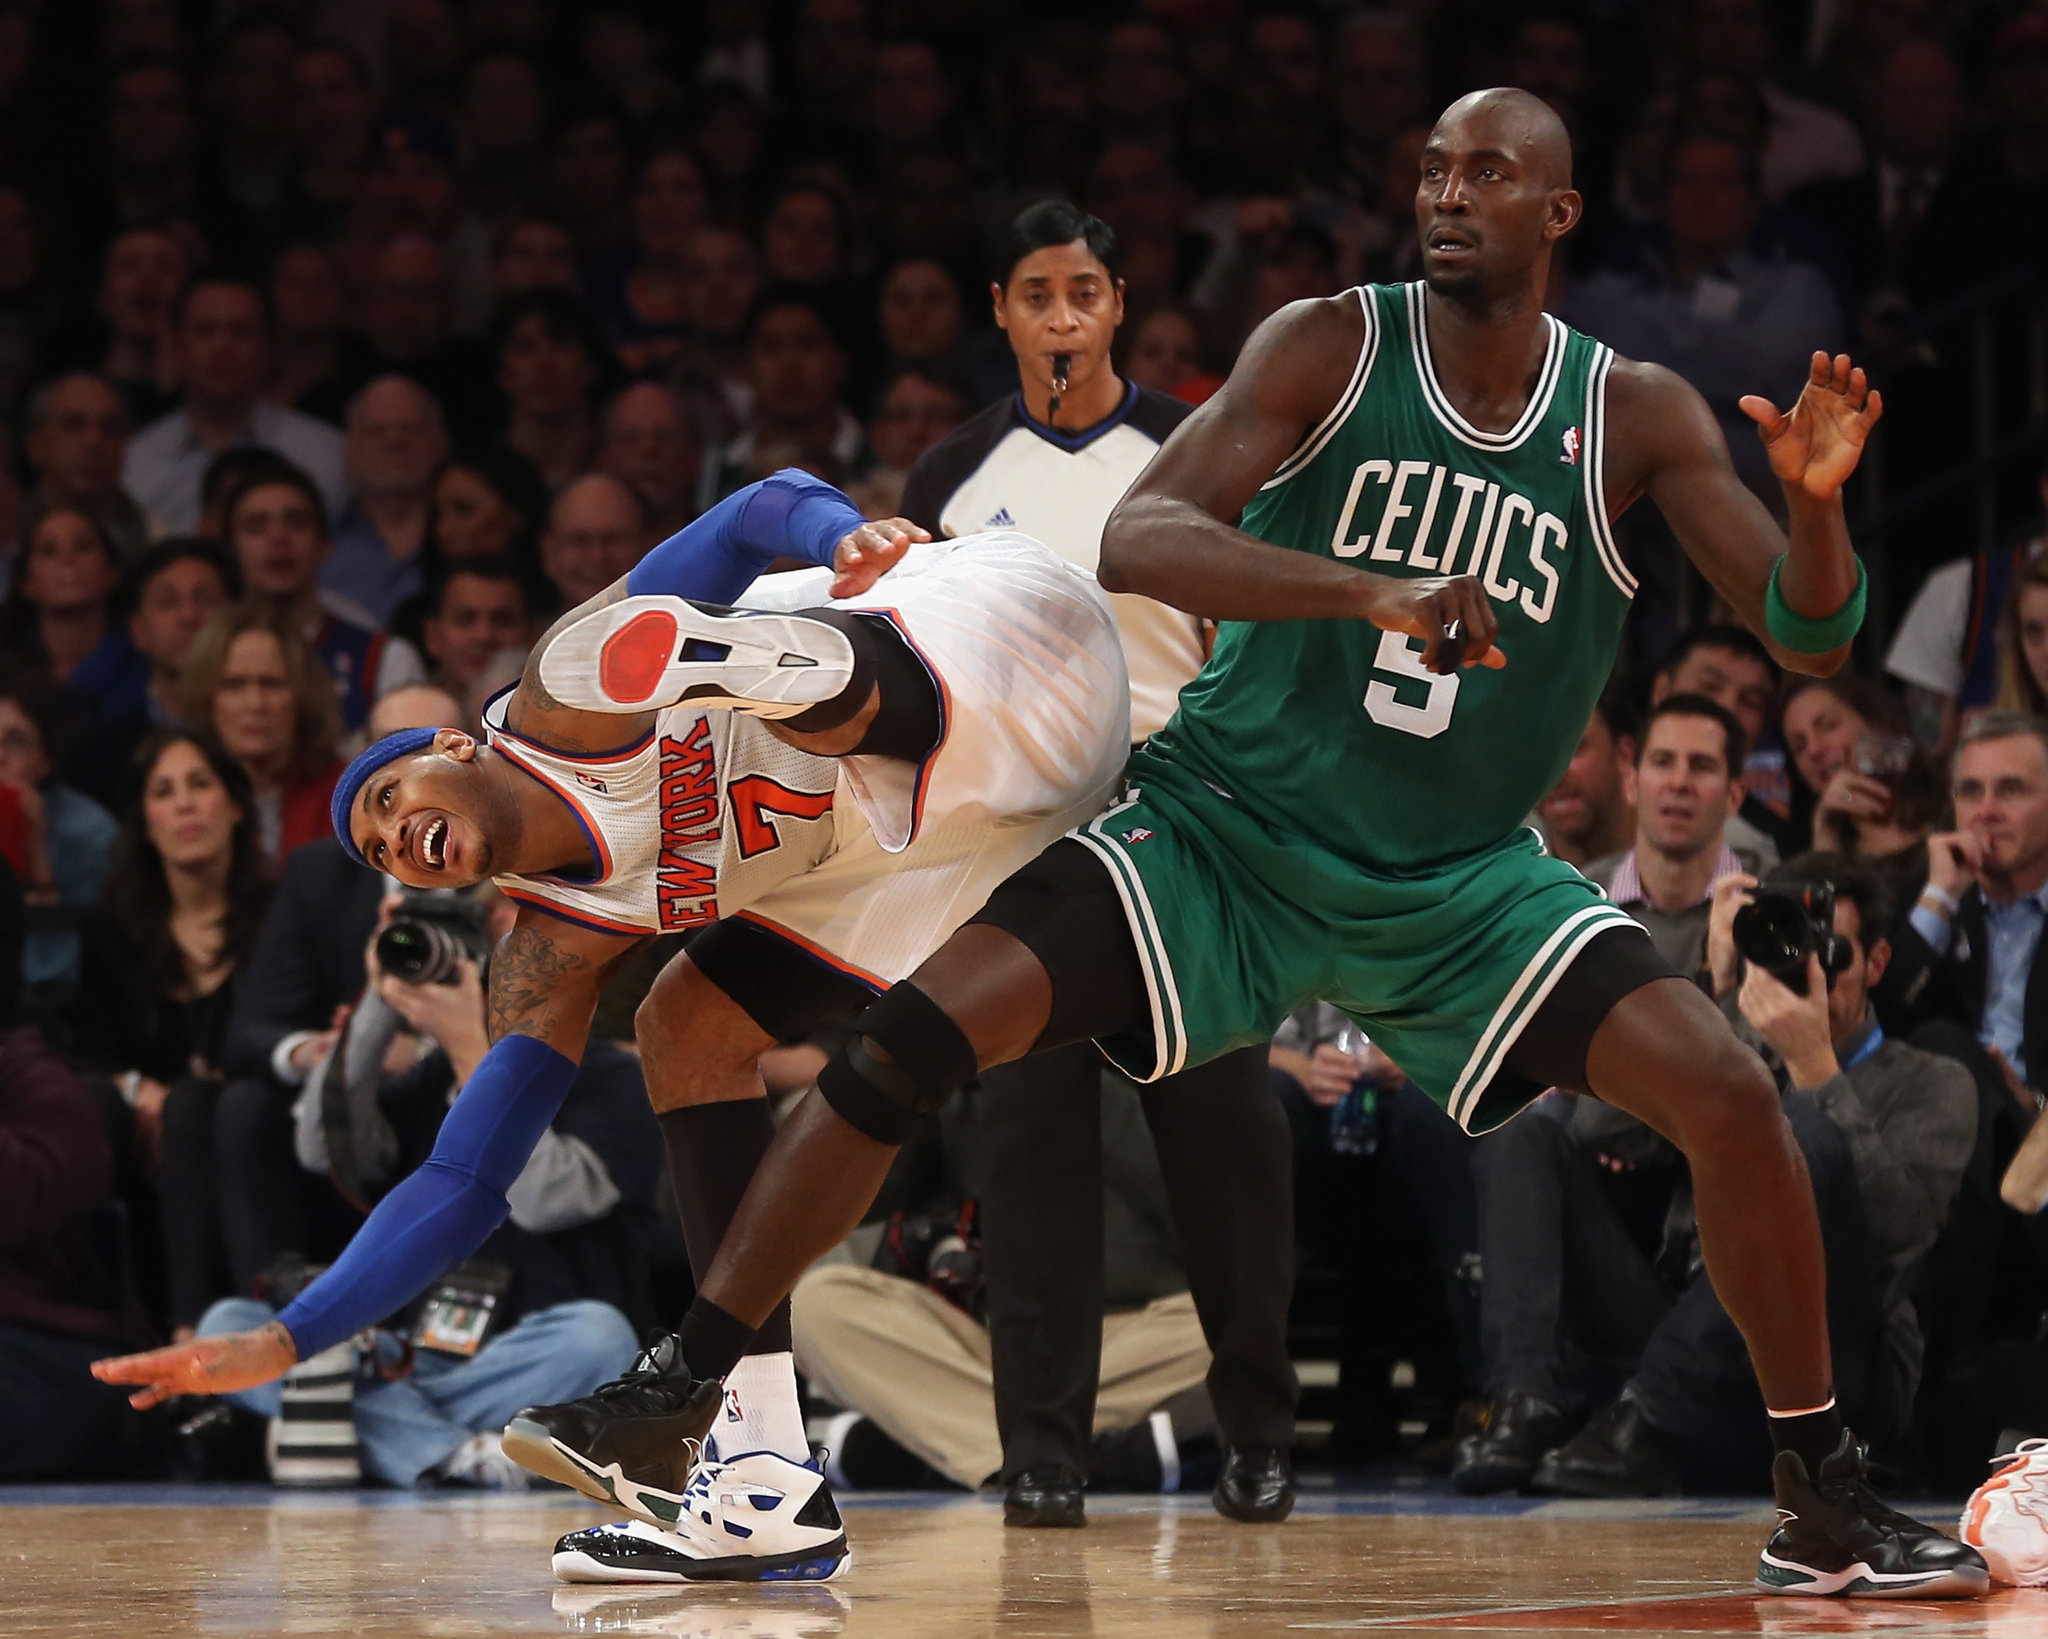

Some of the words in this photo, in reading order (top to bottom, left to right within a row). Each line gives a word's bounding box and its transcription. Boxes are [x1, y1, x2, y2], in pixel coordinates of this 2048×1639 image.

[1330, 458, 1569, 625] CELTICS
[1363, 628, 1462, 740] 5
[659, 715, 723, 850] YORK
[727, 772, 836, 861] 7
